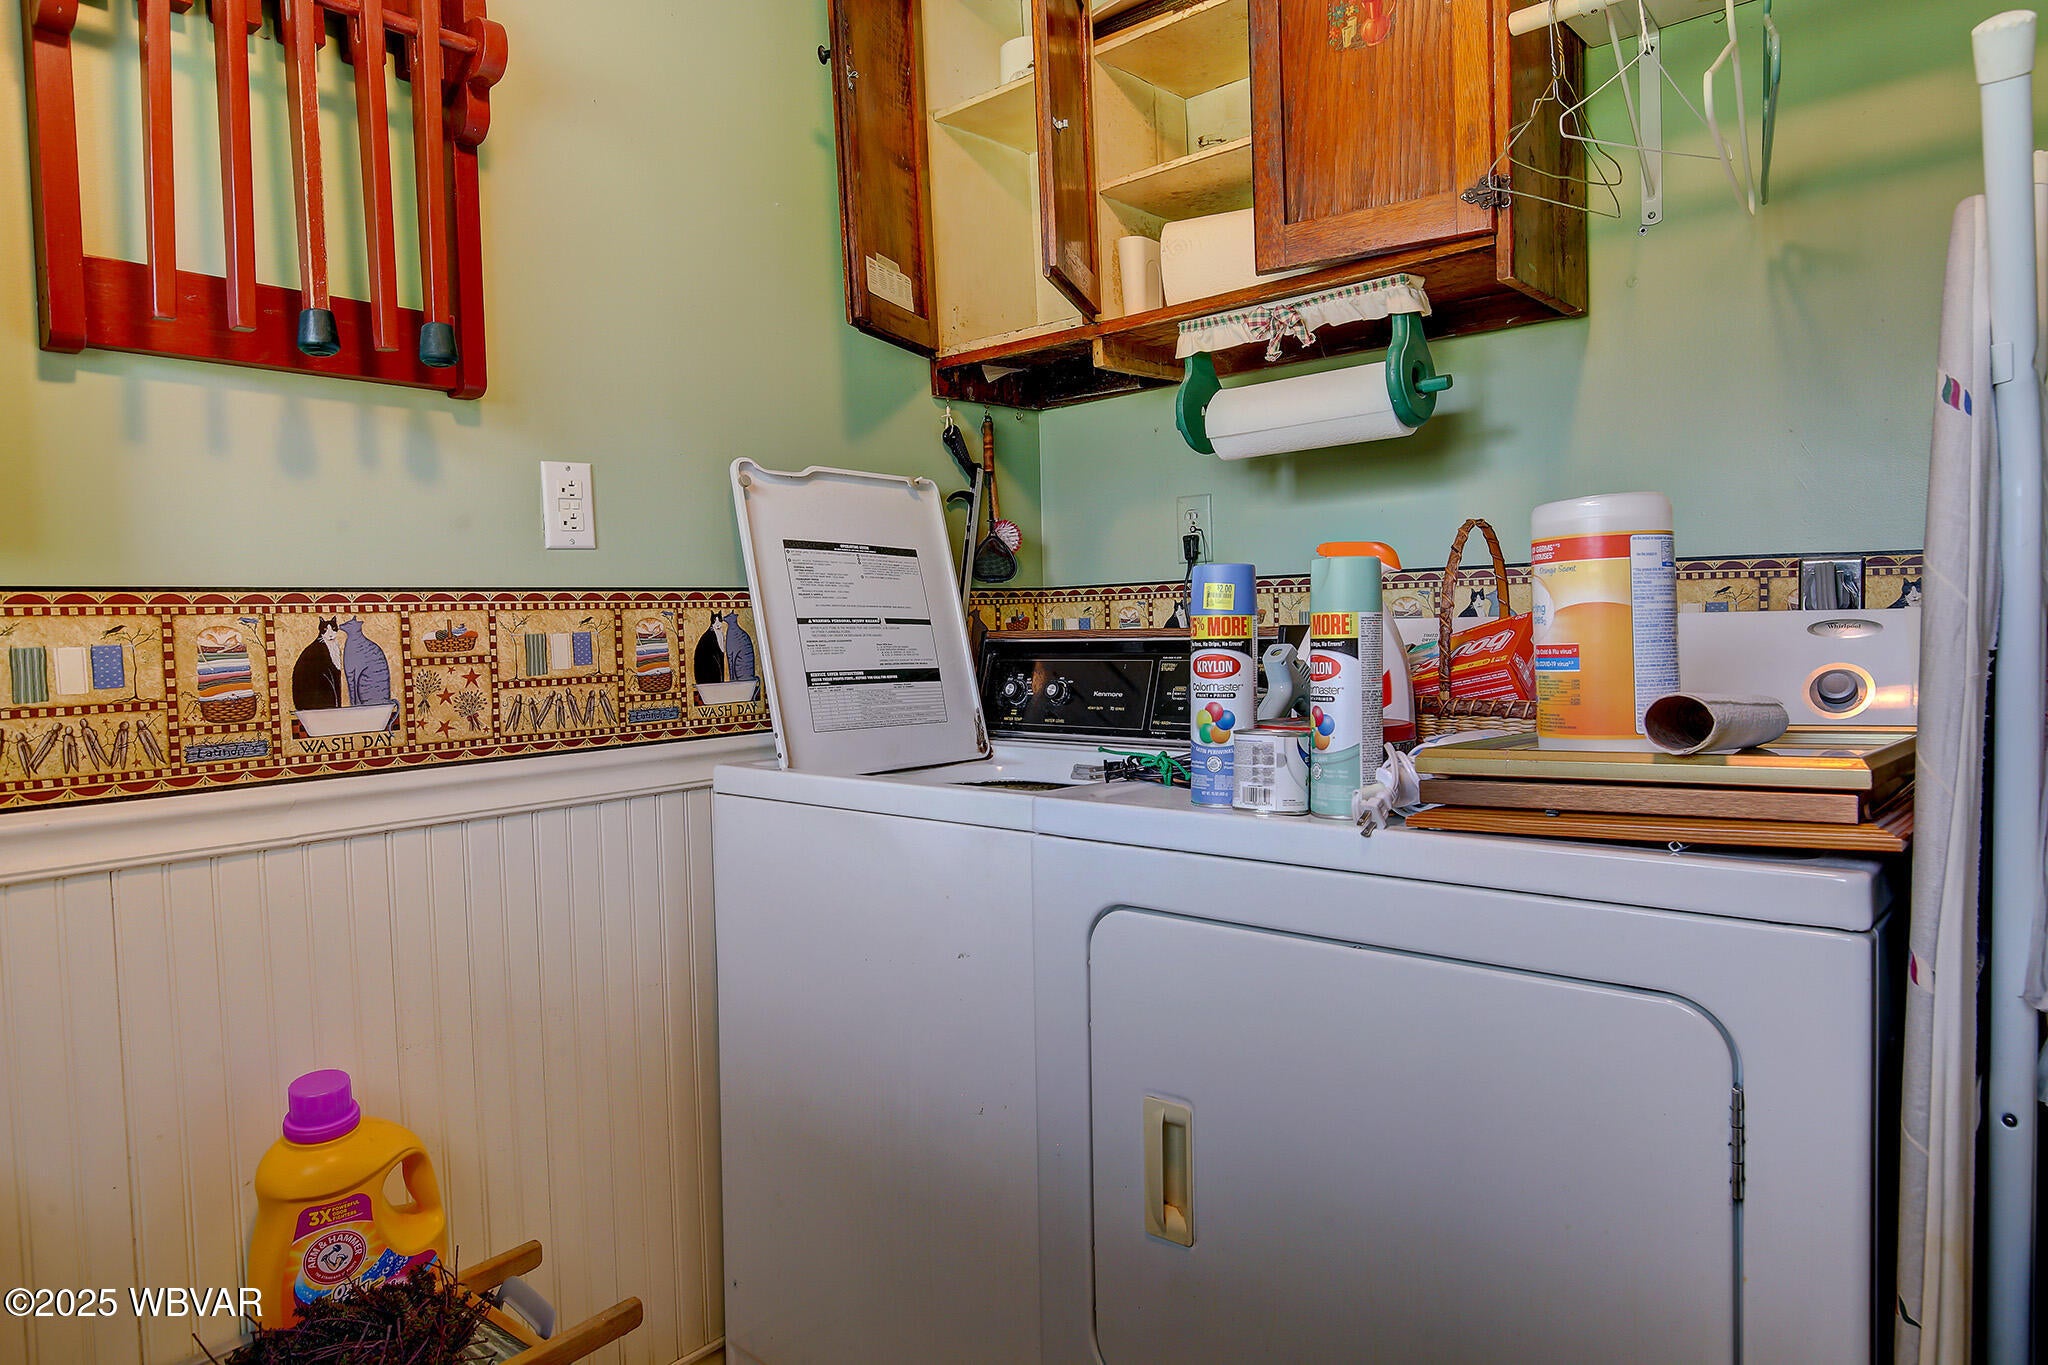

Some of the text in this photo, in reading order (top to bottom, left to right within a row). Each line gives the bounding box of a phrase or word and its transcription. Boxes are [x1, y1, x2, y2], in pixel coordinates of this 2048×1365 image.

[1558, 565, 1577, 573] Scent
[1207, 616, 1247, 637] MORE
[1312, 614, 1350, 635] MORE
[1197, 660, 1233, 673] KRYLON
[1311, 661, 1333, 675] YLON
[1093, 690, 1123, 698] Kenmore
[698, 702, 757, 718] WASH DAY
[299, 732, 393, 754] WASH DAY
[332, 1199, 360, 1212] POWERFUL
[309, 1207, 333, 1227] 3X
[308, 1234, 363, 1269] ARM & HAMMER
